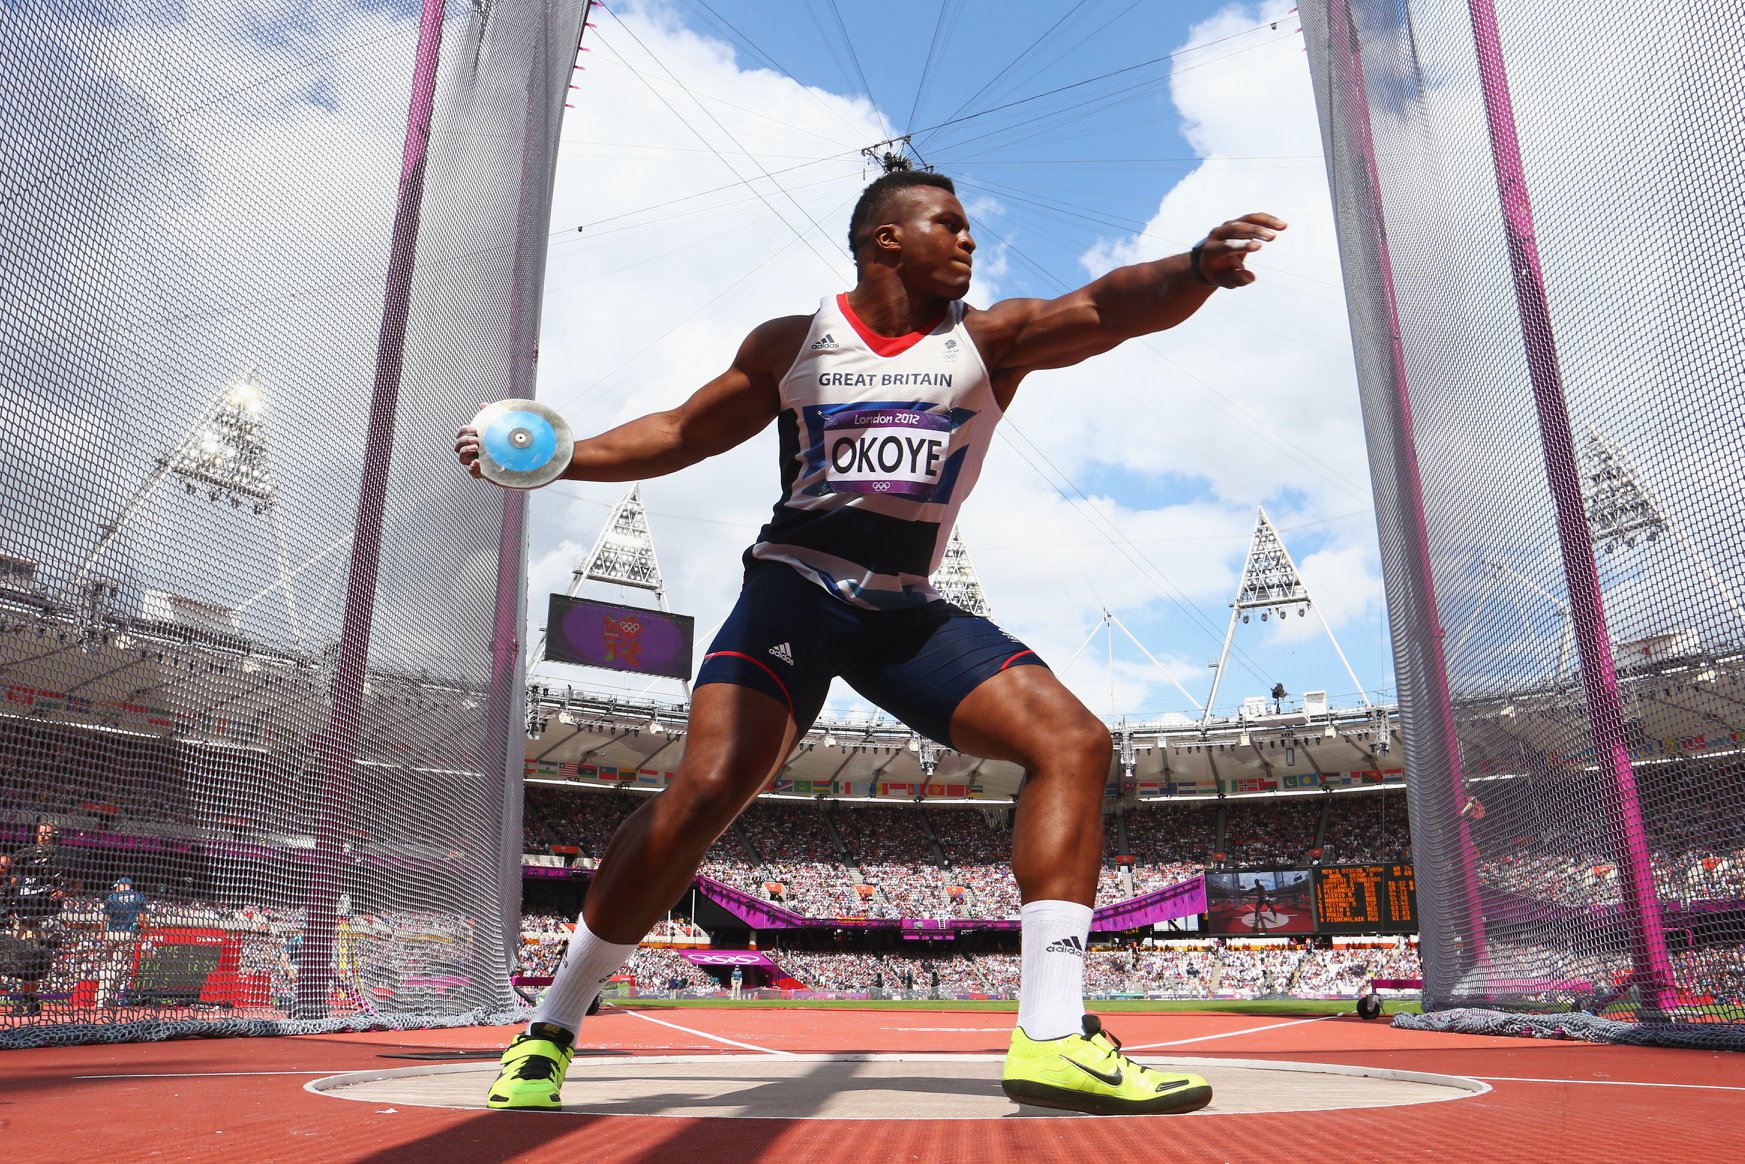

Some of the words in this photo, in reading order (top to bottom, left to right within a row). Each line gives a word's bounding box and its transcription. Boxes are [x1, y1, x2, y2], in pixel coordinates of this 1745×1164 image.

[818, 372, 877, 386] GREAT
[881, 374, 952, 387] BRITAIN
[854, 412, 893, 425] London
[894, 412, 920, 424] 2012
[832, 436, 942, 476] OKOYE
[768, 648, 794, 666] adidas
[1046, 944, 1085, 958] adida
